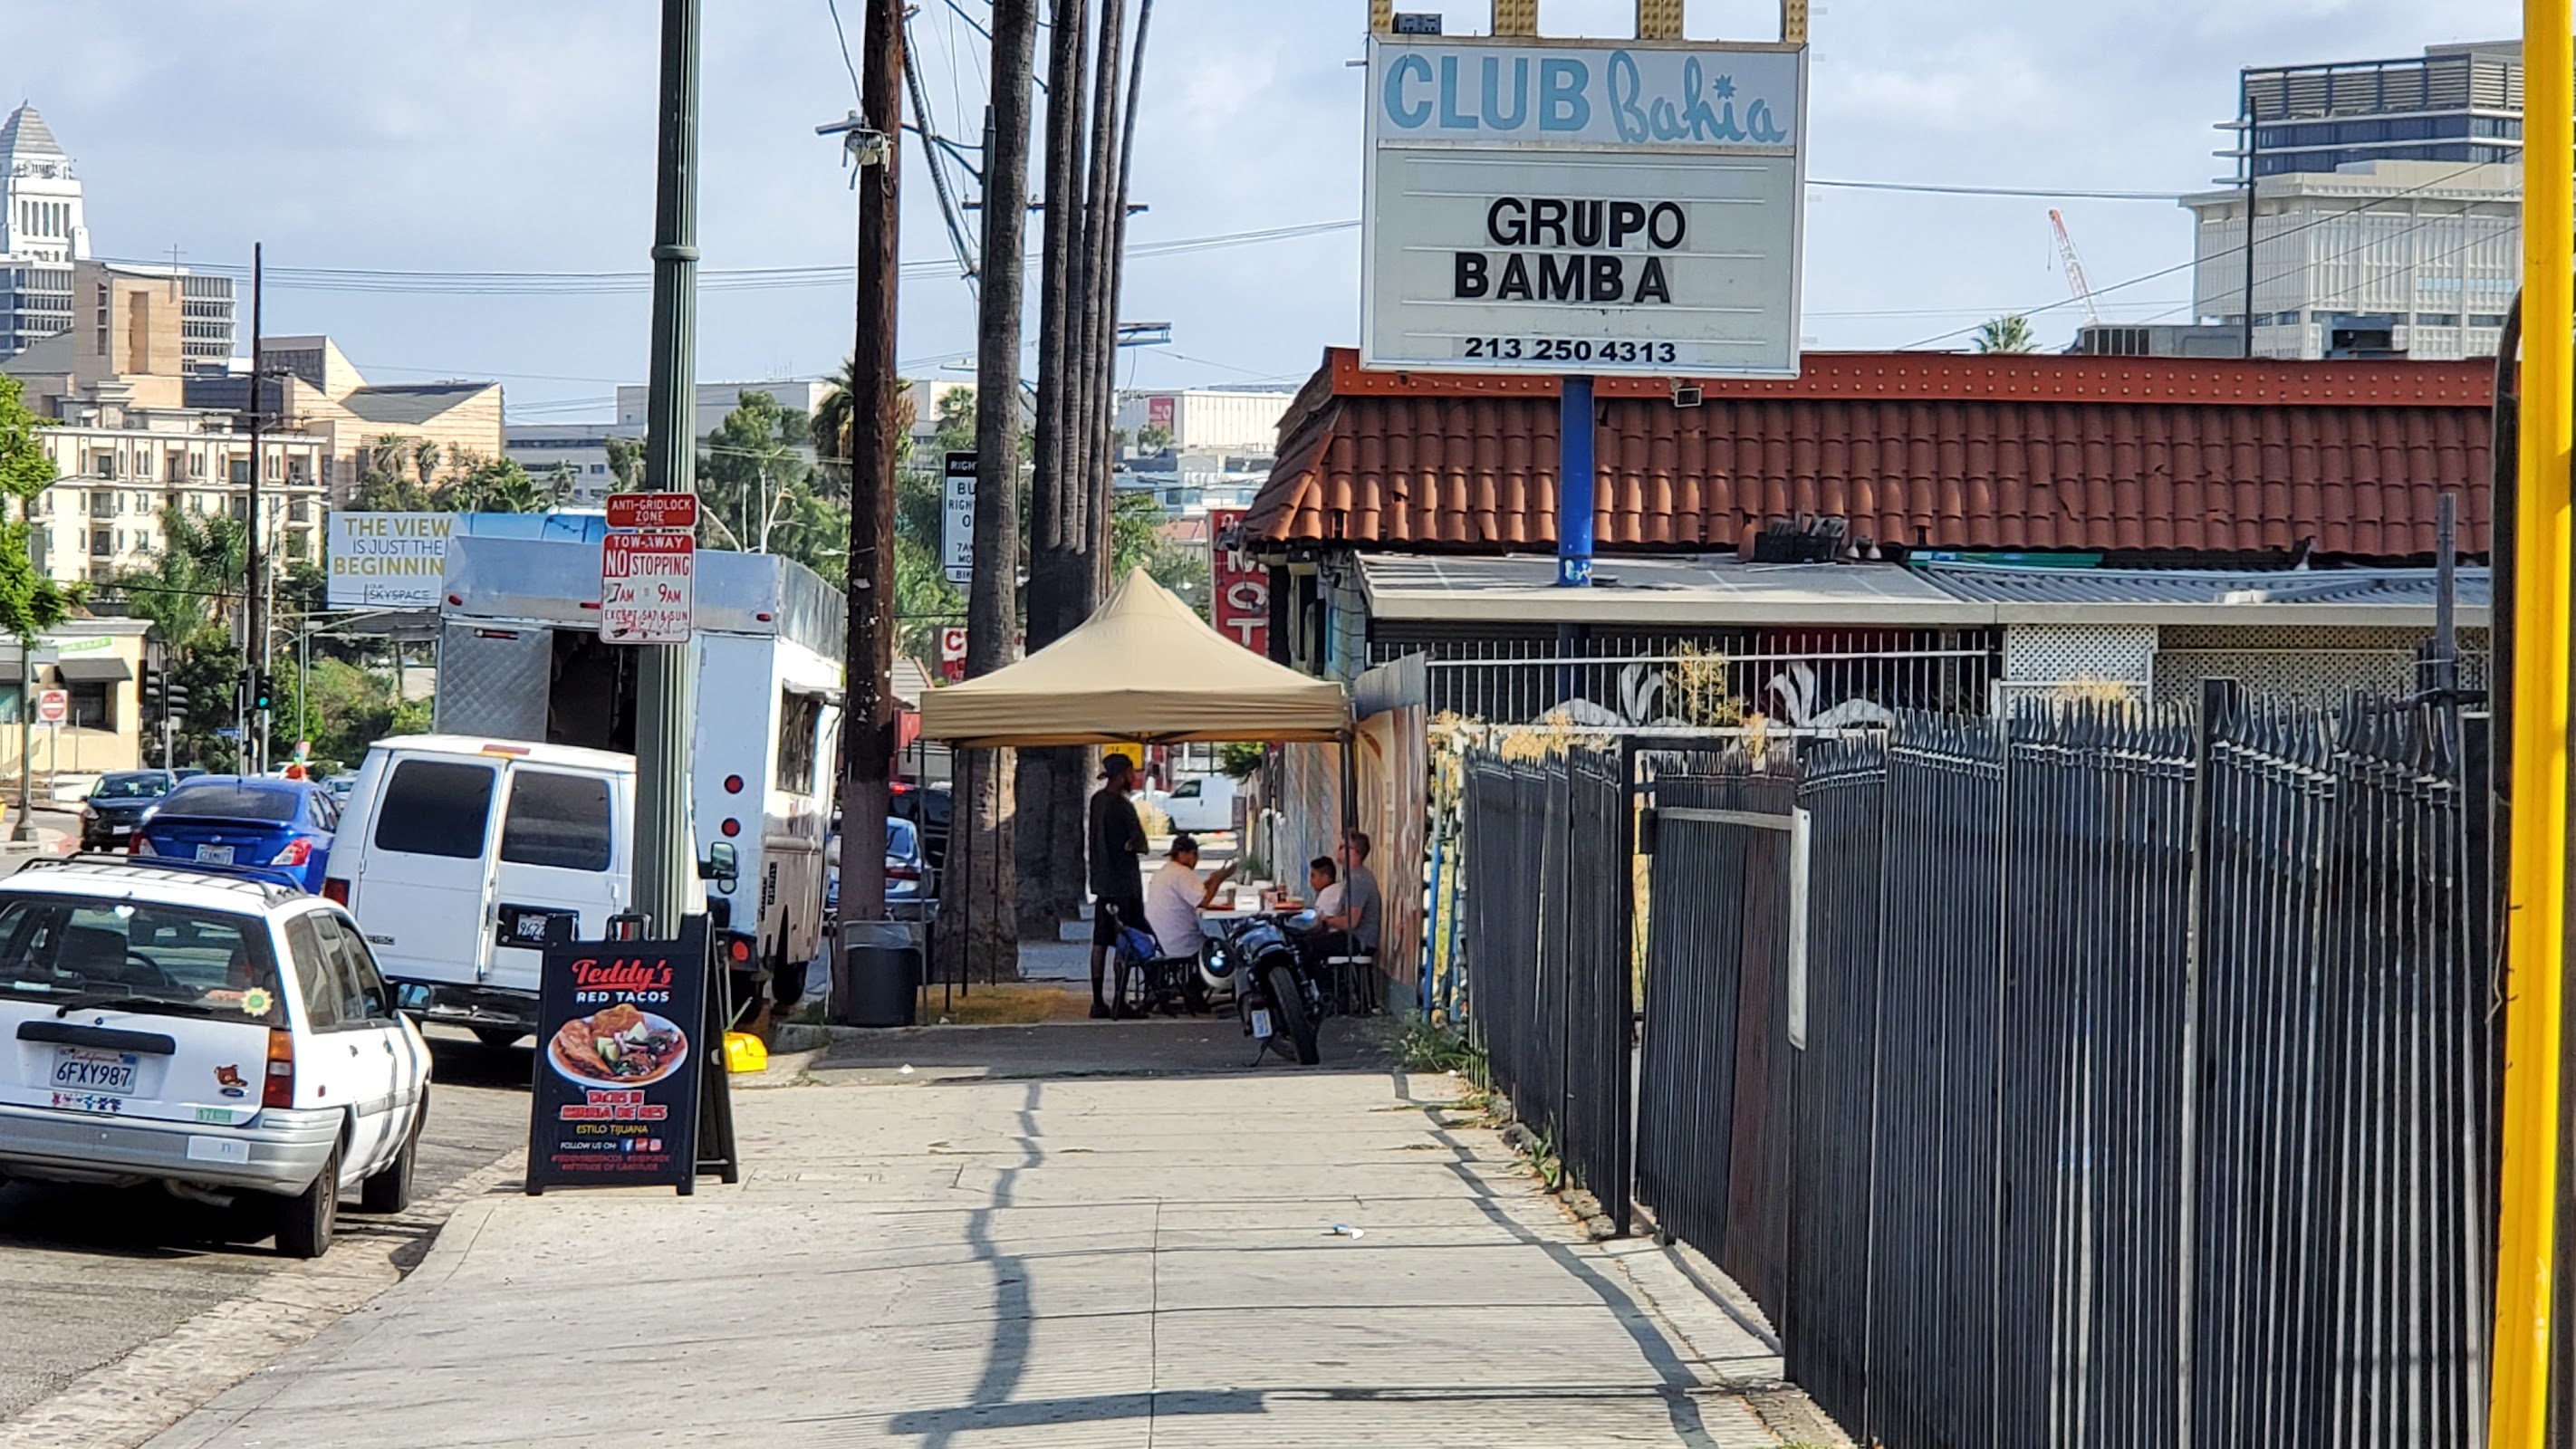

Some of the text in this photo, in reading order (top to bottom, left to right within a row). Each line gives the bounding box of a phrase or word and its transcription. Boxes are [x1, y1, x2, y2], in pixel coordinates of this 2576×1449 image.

[1384, 50, 1788, 144] CLUB Bahia
[1487, 197, 1687, 249] GRUPO
[1455, 251, 1671, 304] BAMBA
[1464, 336, 1677, 364] 213 250 4313
[950, 460, 977, 471] RIGH
[957, 482, 976, 495] BU
[611, 499, 693, 512] ANTI-GRIDLOCK
[948, 499, 973, 511] RIGH
[635, 510, 666, 523] ZONE
[344, 518, 452, 537] THE VIEW
[353, 539, 443, 556] IS JUST THE
[613, 535, 685, 550] TOW-AWAY
[333, 556, 445, 576] BEGINNIN
[605, 549, 690, 577] NO STOPPING
[370, 590, 431, 600] SKYSPACE
[658, 582, 681, 604] 9AM
[604, 609, 638, 621] EXCEPT
[669, 609, 688, 621] SUN
[572, 959, 674, 992] Teddy's
[576, 992, 670, 1003] RED TACOS
[56, 1061, 131, 1088] 6FXY987
[576, 1125, 649, 1136] ESTILO TIJUANA
[560, 1141, 591, 1149] FOLLOW
[591, 1141, 602, 1149] US
